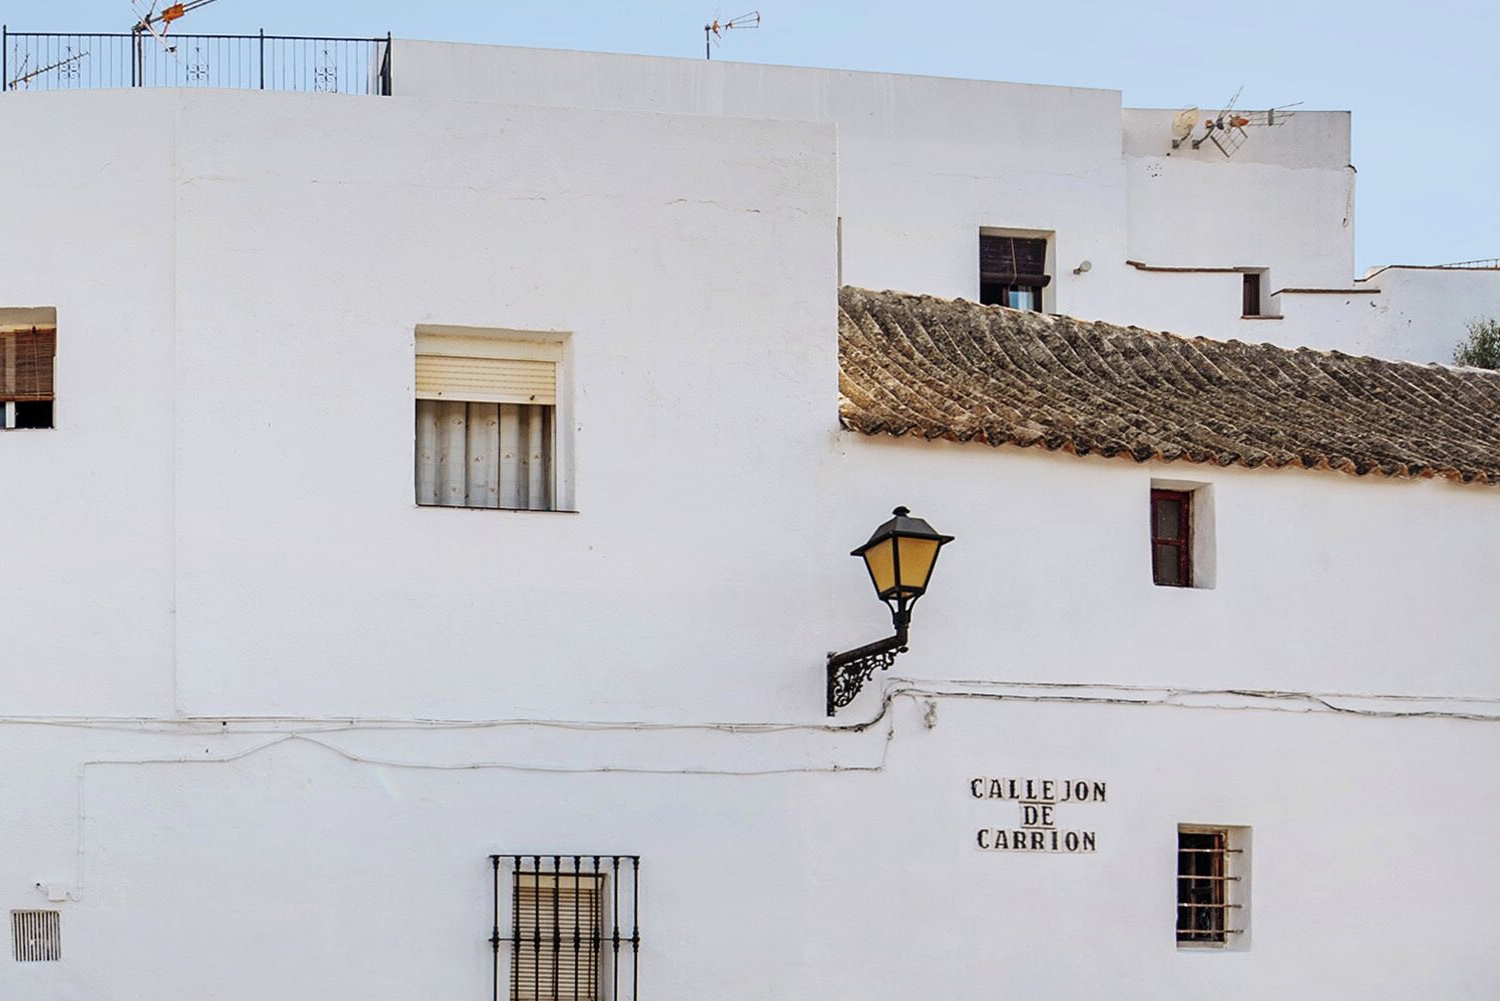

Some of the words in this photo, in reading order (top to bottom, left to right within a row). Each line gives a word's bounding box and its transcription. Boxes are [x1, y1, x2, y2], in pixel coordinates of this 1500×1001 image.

[970, 778, 1106, 802] CALLEJON
[1023, 806, 1054, 826] DE
[976, 829, 1096, 851] CARRION
